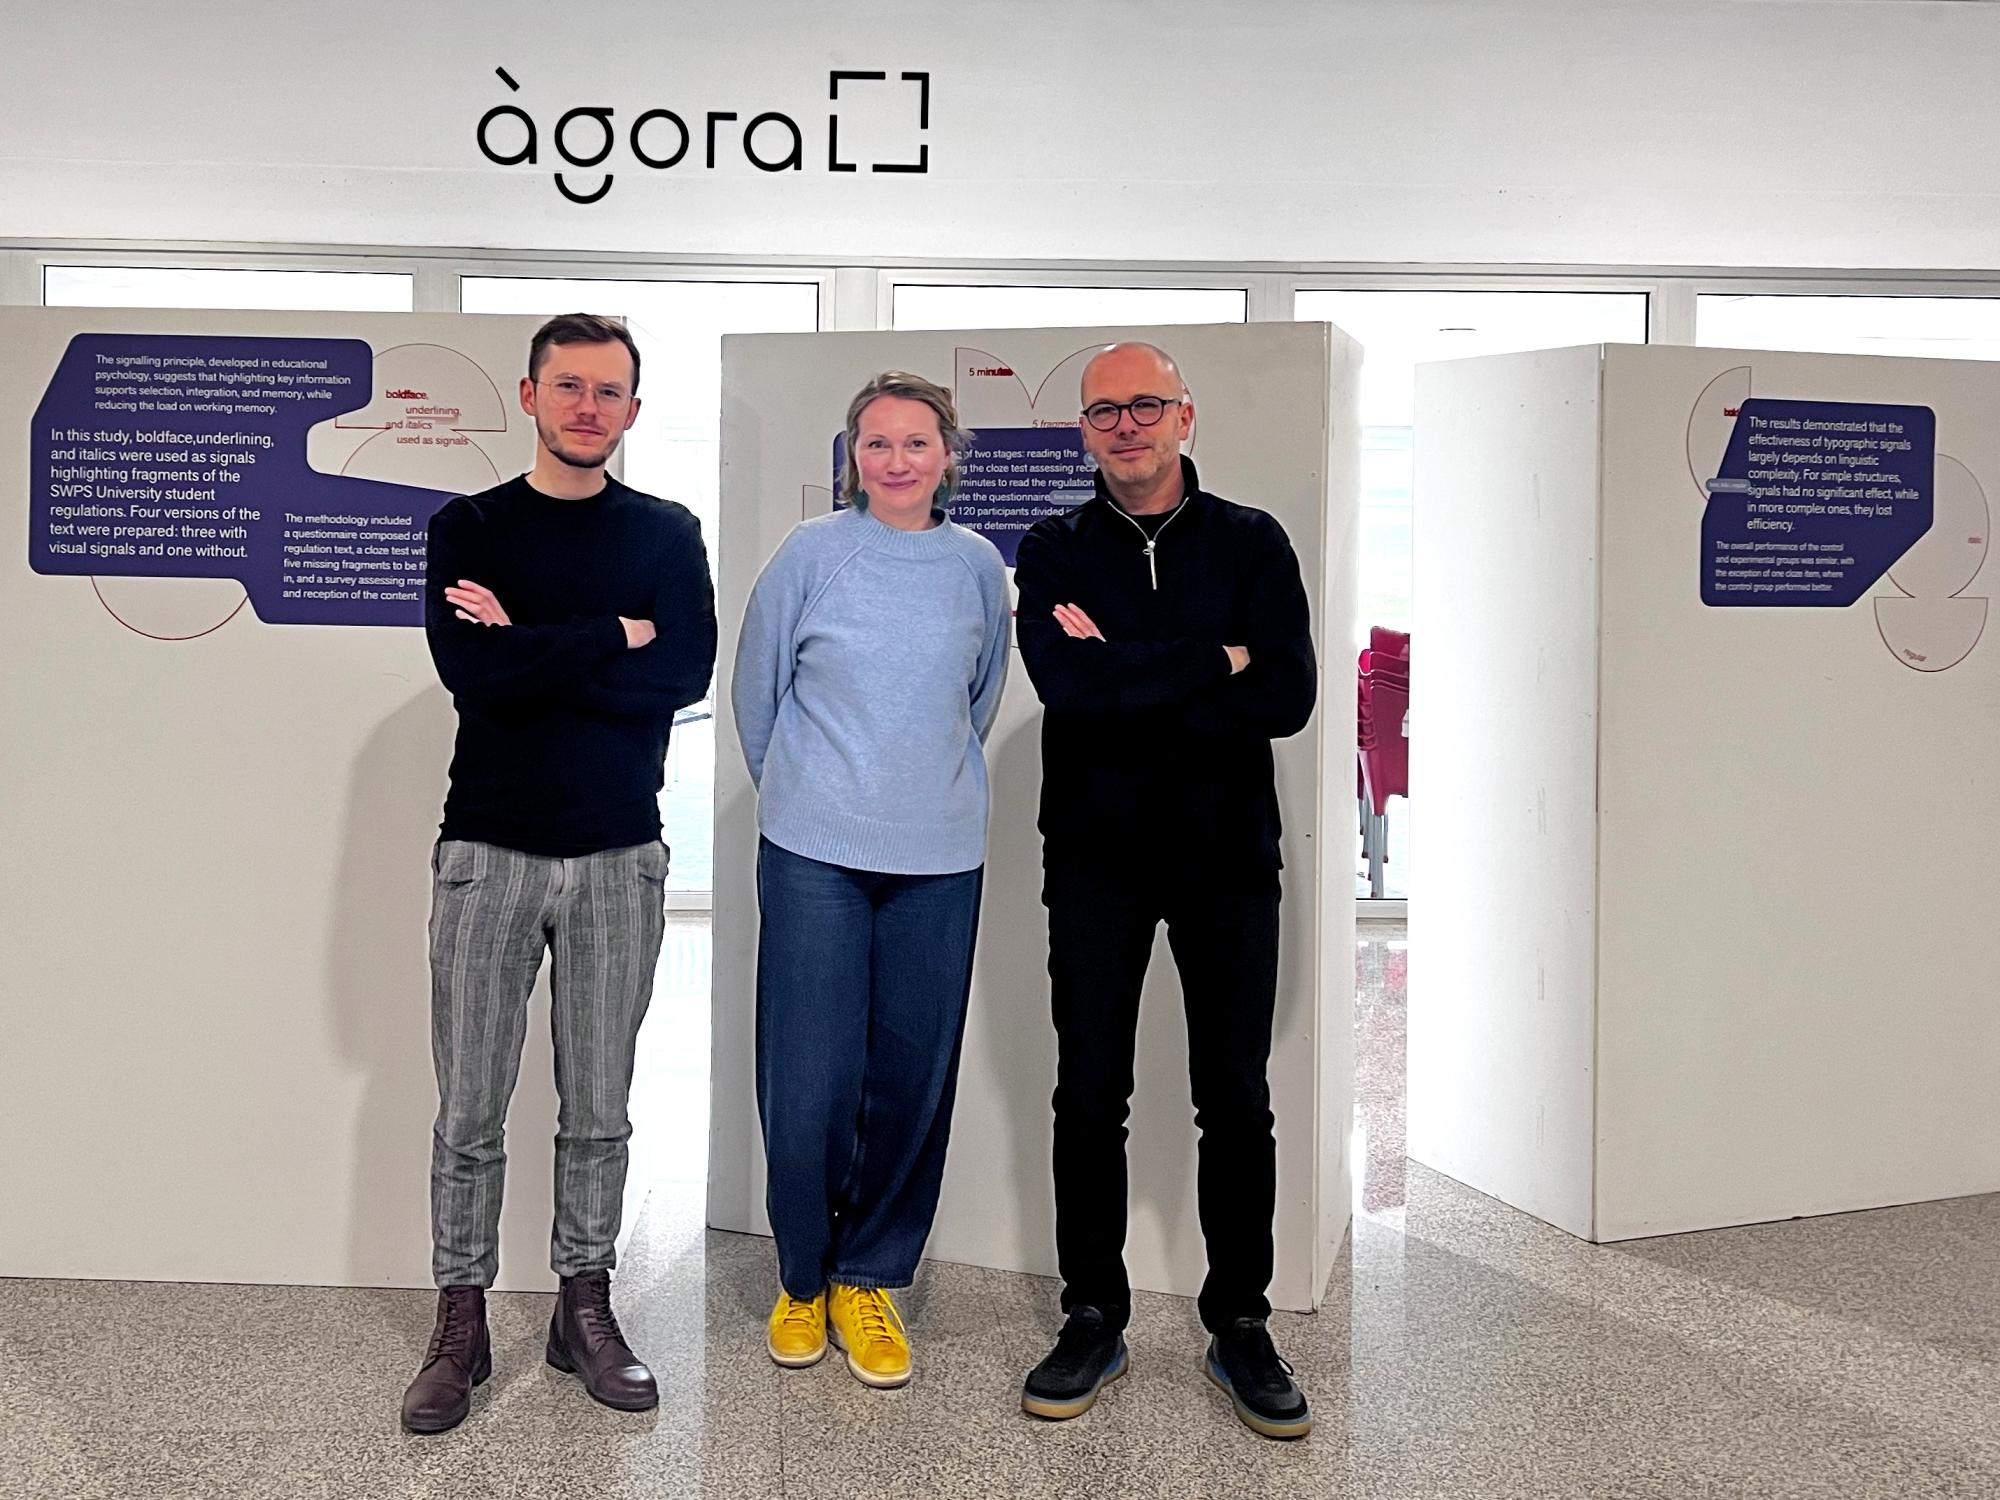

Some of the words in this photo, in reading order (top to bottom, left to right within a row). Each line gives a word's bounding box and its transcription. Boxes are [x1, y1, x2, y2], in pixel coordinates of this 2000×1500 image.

[96, 354, 114, 364] The
[116, 355, 160, 367] signalling
[162, 356, 206, 368] principle,
[208, 357, 259, 369] developed
[260, 358, 270, 367] in
[272, 358, 328, 369] educational
[95, 369, 152, 382] psychology,
[153, 370, 196, 383] suggests
[198, 371, 218, 381] that
[218, 372, 276, 385] highlighting
[277, 373, 294, 385] key
[296, 373, 352, 384] information
[969, 368, 974, 376] 5
[94, 384, 138, 397] supports
[138, 385, 184, 398] selection,
[186, 386, 240, 399] integration,
[242, 387, 260, 397] and
[262, 390, 306, 400] memory,
[306, 389, 332, 399] while
[94, 399, 138, 412] reducing
[139, 400, 155, 410] the
[156, 401, 178, 410] load
[178, 403, 192, 411] on
[194, 401, 232, 414] working
[234, 404, 278, 414] memory.
[386, 421, 403, 429] and
[406, 421, 432, 429] italics
[1749, 416, 1768, 428] The
[1769, 417, 1801, 430] results
[1802, 418, 1867, 432] demonstrated
[1868, 421, 1887, 433] that
[1888, 422, 1904, 433] the
[51, 428, 64, 441] In
[66, 429, 90, 442] this
[93, 429, 133, 446] study,
[397, 435, 420, 444] used
[436, 437, 469, 447] signals
[1748, 434, 1811, 447] effectiveness
[1812, 436, 1823, 447] of
[1823, 436, 1878, 452] typographic
[1879, 438, 1912, 453] signals
[50, 447, 76, 460] and
[79, 448, 116, 461] italics
[118, 451, 153, 462] were
[156, 449, 188, 462] used
[190, 453, 207, 463] as
[209, 450, 256, 467] signals
[974, 449, 991, 458] two
[992, 449, 1026, 460] stages:
[1027, 449, 1062, 460] reading
[1063, 448, 1078, 457] the
[1748, 450, 1781, 465] largely
[1782, 451, 1823, 466] depends
[1824, 455, 1837, 464] on
[1838, 453, 1880, 468] linguistic
[50, 466, 128, 483] highlighting
[131, 468, 200, 485] fragments
[202, 469, 216, 482] of
[218, 469, 241, 482] the
[970, 463, 985, 472] the
[986, 463, 1009, 472] cloze
[1011, 463, 1028, 472] test
[1029, 463, 1074, 474] assessing
[1748, 467, 1802, 483] complexity.
[1803, 469, 1820, 481] For
[1821, 469, 1852, 484] simple
[1853, 470, 1902, 485] structures,
[960, 477, 996, 486] minutes
[998, 477, 1007, 486] to
[1009, 477, 1030, 486] read
[1031, 477, 1046, 486] the
[1048, 477, 1095, 488] regulation
[50, 485, 93, 498] SWPS
[96, 486, 162, 503] University
[164, 487, 216, 500] student
[972, 492, 987, 501] the
[988, 492, 1050, 503] questionnaire
[1747, 484, 1782, 499] signals
[1782, 485, 1800, 497] had
[1802, 488, 1815, 497] no
[1816, 486, 1864, 501] significant
[1865, 487, 1894, 501] effect,
[1895, 488, 1919, 500] while
[50, 503, 126, 520] regulations.
[130, 505, 162, 518] Four
[164, 505, 220, 519] versions
[222, 507, 236, 519] of
[238, 507, 261, 520] the
[958, 506, 975, 515] 120
[977, 506, 1030, 517] participants
[1030, 506, 1064, 515] divided
[1747, 501, 1757, 512] in
[1758, 504, 1784, 513] more
[1785, 502, 1826, 517] complex
[1827, 505, 1852, 517] ones,
[1853, 503, 1874, 518] they
[1875, 504, 1893, 515] lost
[284, 513, 303, 523] The
[304, 514, 369, 527] methodology
[370, 515, 412, 525] included
[1747, 518, 1796, 533] efficiency.
[49, 522, 74, 535] text
[76, 525, 110, 535] were
[113, 523, 178, 540] prepared:
[180, 524, 216, 538] three
[219, 525, 248, 538] with
[291, 528, 358, 542] questionnaire
[359, 530, 411, 543] composed
[412, 531, 422, 541] of
[48, 540, 86, 554] visual
[89, 541, 136, 558] signals
[138, 542, 164, 555] and
[166, 546, 192, 556] one
[195, 544, 248, 557] without.
[283, 543, 333, 555] regulation
[334, 544, 355, 556] text,
[364, 544, 389, 555] cloze
[391, 545, 410, 555] test
[411, 546, 426, 555] wit
[283, 558, 301, 568] five
[303, 558, 340, 571] missing
[341, 559, 391, 572] fragments
[392, 560, 403, 570] to
[404, 560, 417, 570] be
[283, 573, 295, 585] in,
[296, 574, 315, 583] and
[316, 576, 323, 584] a
[324, 576, 357, 586] survey
[358, 575, 405, 587] assessing
[283, 588, 301, 598] and
[303, 588, 349, 601] reception
[351, 589, 361, 599] of
[362, 590, 378, 599] the
[380, 590, 419, 600] content.
